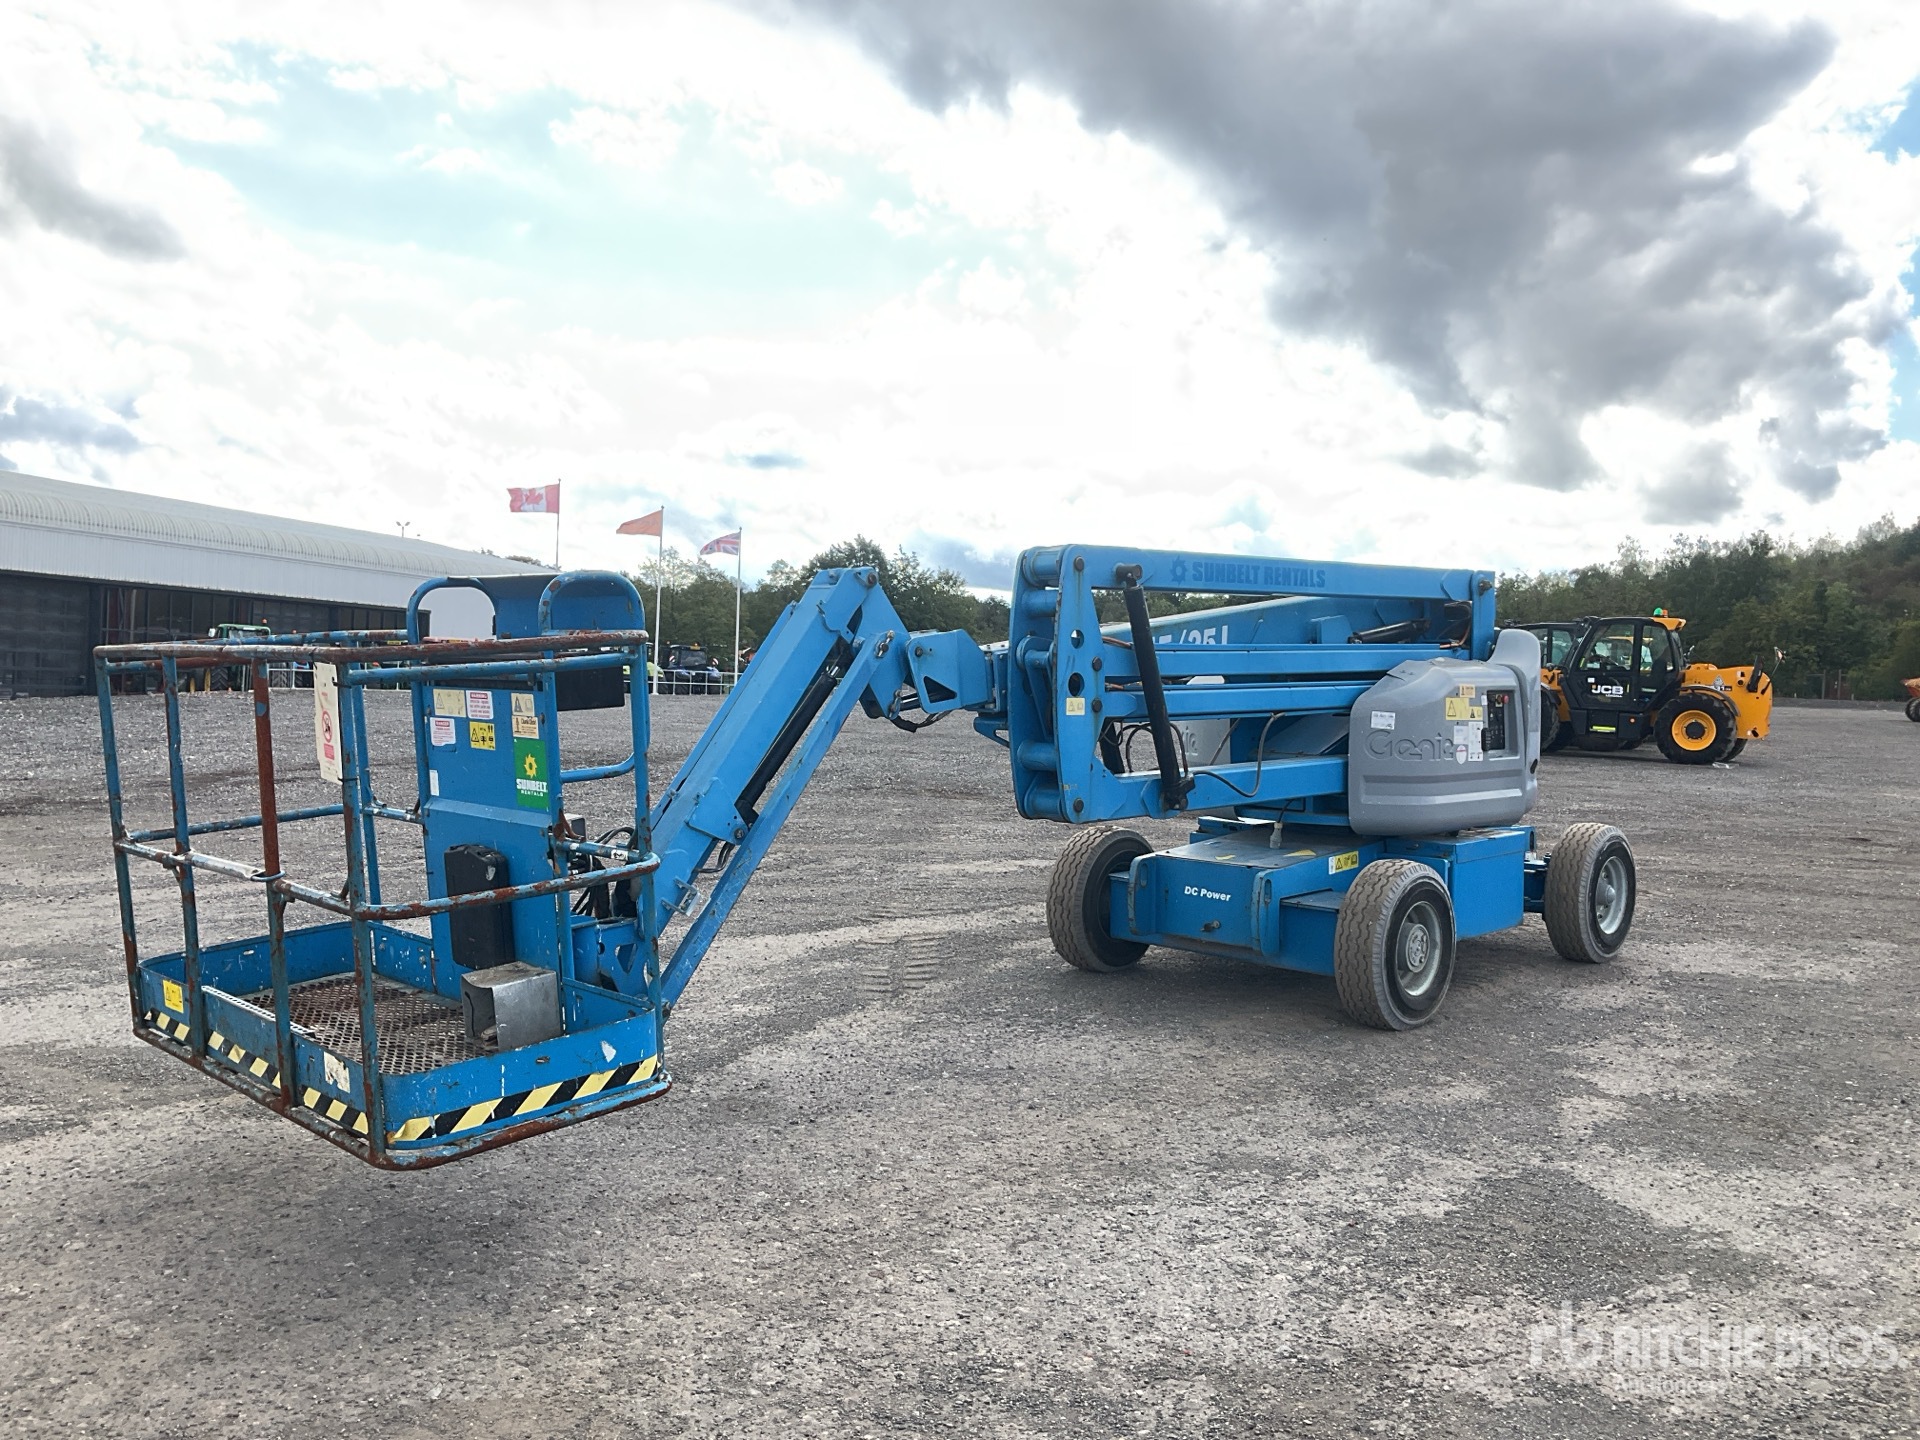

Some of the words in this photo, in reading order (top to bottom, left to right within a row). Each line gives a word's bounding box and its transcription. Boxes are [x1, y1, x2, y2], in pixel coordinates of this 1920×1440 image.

[1192, 561, 1260, 585] SUNBELT
[1264, 566, 1326, 588] RENTALS
[1591, 685, 1624, 695] JCB
[516, 778, 548, 792] SUNBELT
[1184, 886, 1199, 896] DC
[1200, 888, 1232, 902] Power
